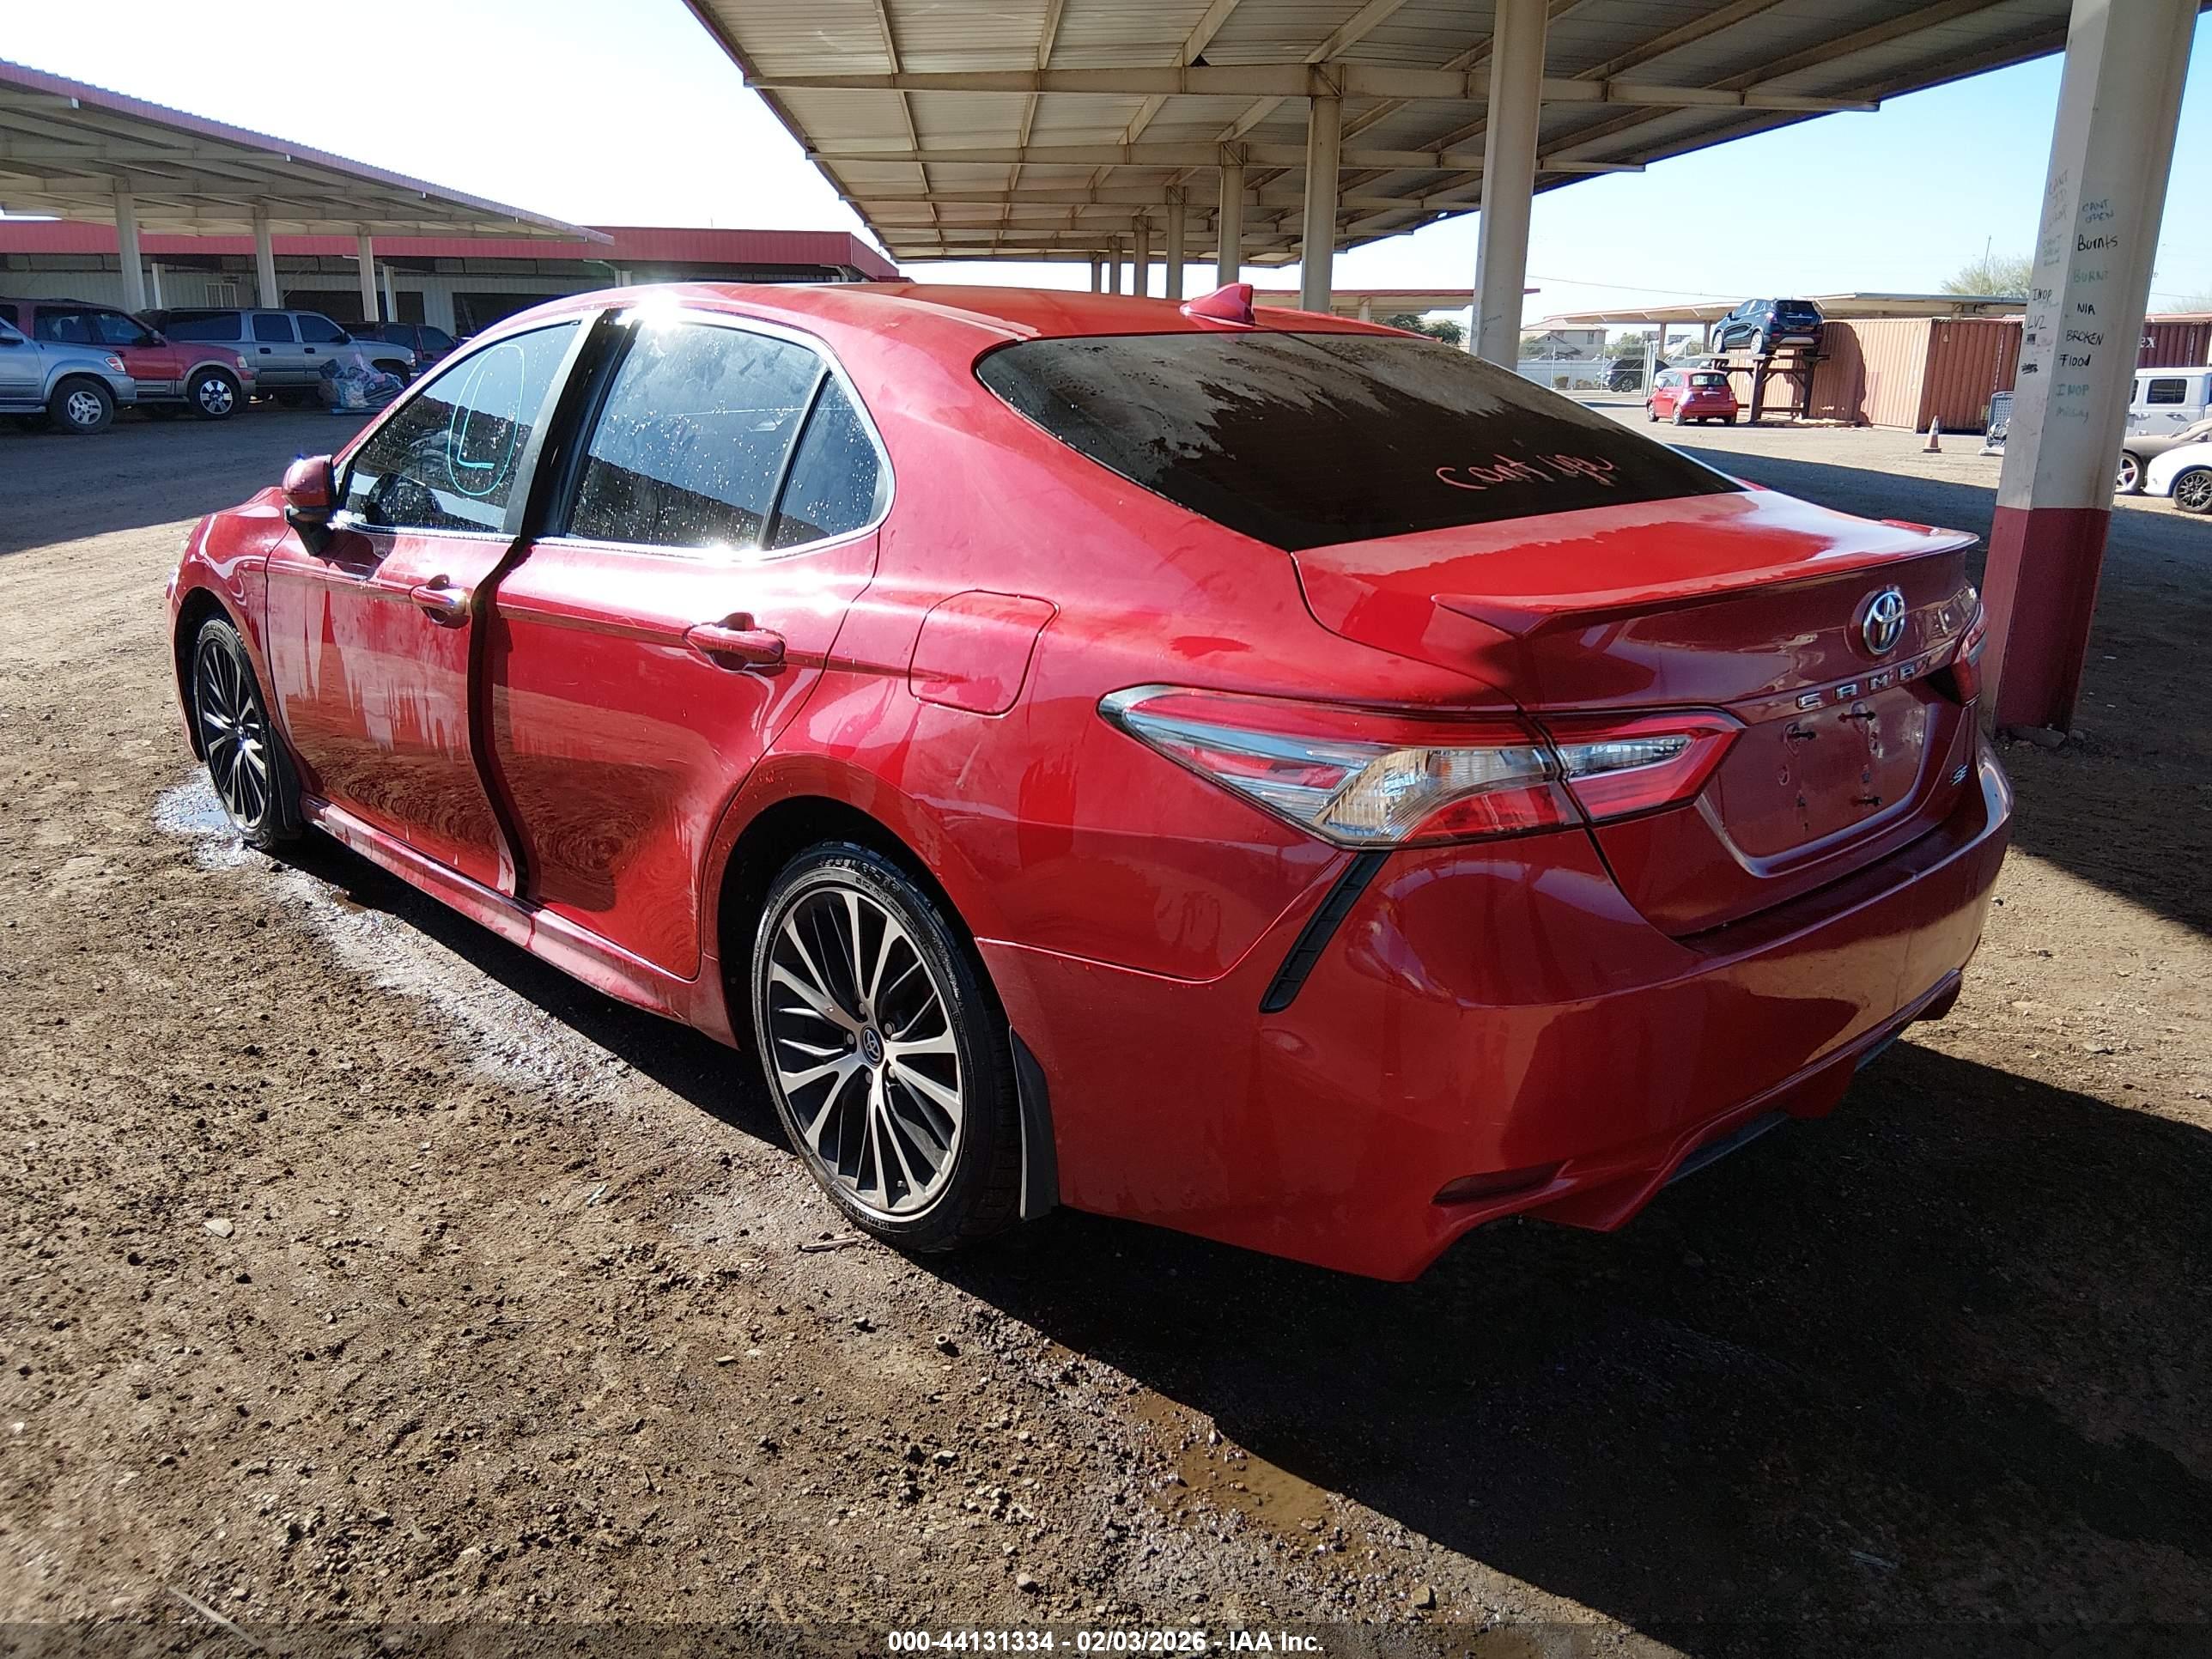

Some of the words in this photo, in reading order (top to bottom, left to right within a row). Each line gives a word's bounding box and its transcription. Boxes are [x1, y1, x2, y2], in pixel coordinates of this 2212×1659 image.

[2082, 198, 2110, 212] CANT
[2033, 288, 2053, 301] INOP
[2066, 329, 2104, 346] BROKEN
[2055, 383, 2090, 397] INOP
